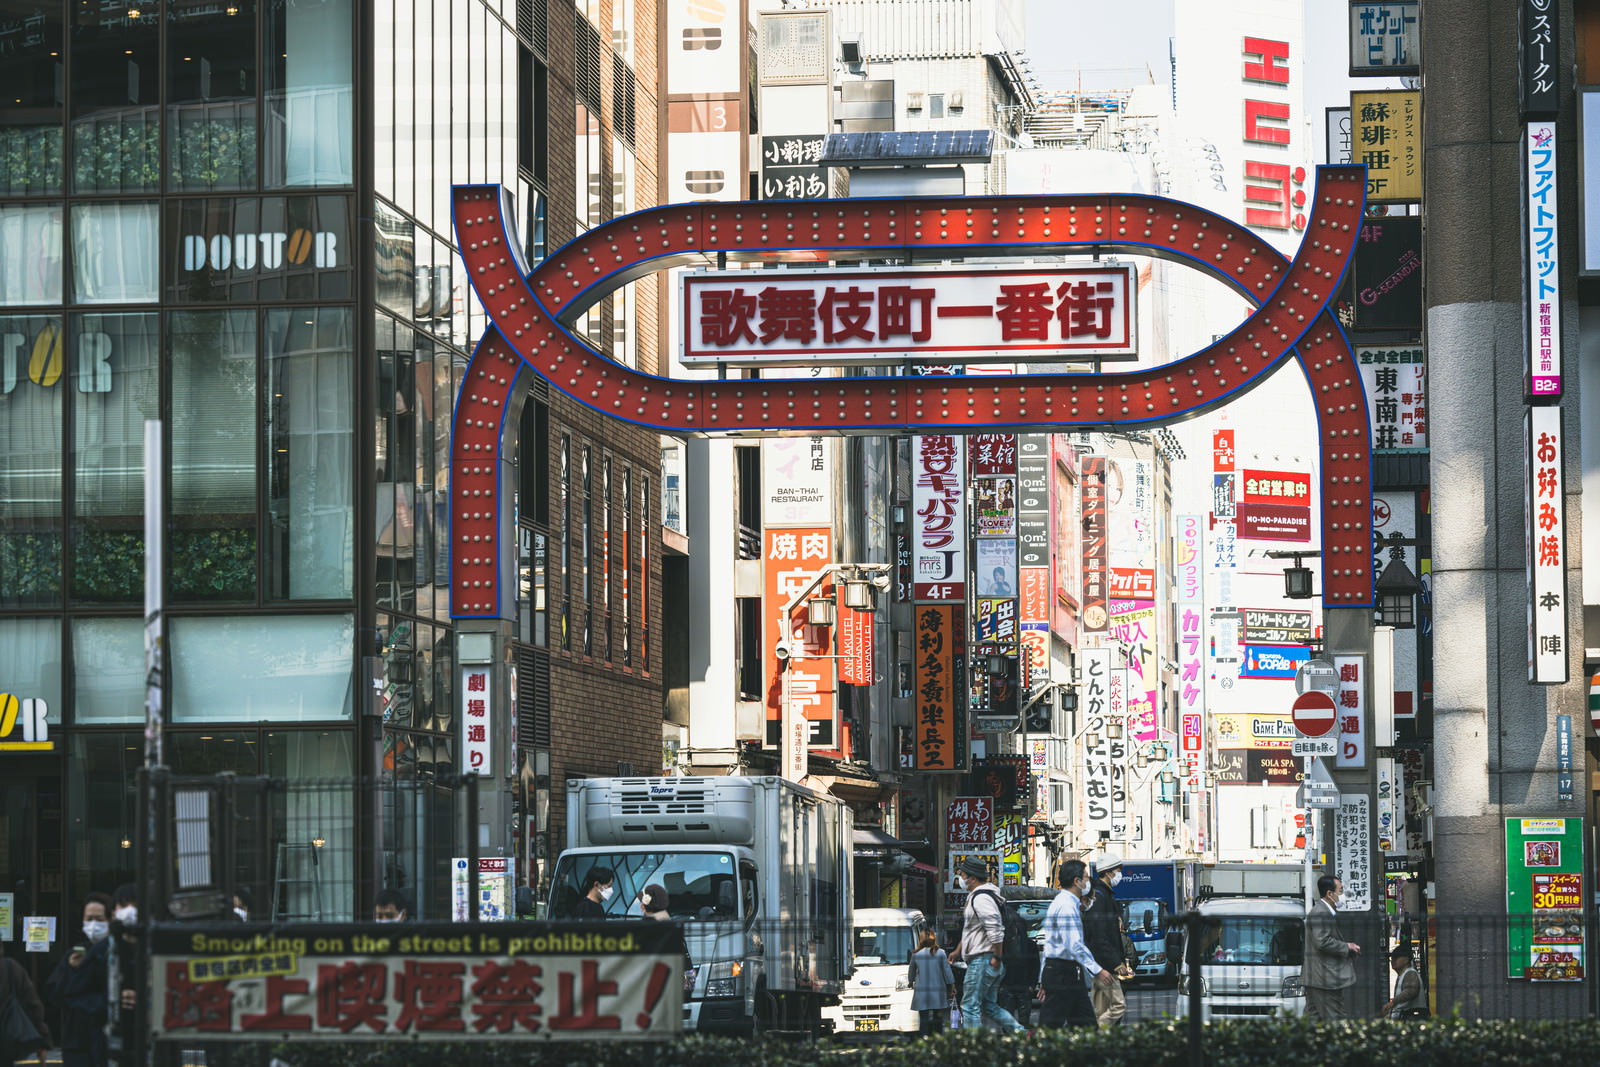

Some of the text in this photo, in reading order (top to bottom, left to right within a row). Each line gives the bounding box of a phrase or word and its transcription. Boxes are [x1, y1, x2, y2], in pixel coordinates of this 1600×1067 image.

[1360, 7, 1416, 35] ポケット
[1368, 37, 1406, 65] ビル
[1531, 15, 1554, 94] スパークル
[765, 139, 823, 164] 小料理
[1404, 99, 1414, 177] エレガンス・ラウンジ
[1361, 226, 1382, 242] 4F
[1531, 150, 1557, 300] ファイトフィット
[184, 228, 337, 271] DOUTOR
[700, 281, 1115, 346] 歌舞伎町一番街
[1540, 303, 1552, 371] 新宿東口駅前
[1360, 350, 1424, 365] 全卓全自動
[1535, 380, 1557, 391] B2F
[1375, 367, 1398, 448] 東南荘
[1414, 366, 1425, 434] リーチ麻雀
[1401, 393, 1413, 445] 専門店
[771, 495, 824, 503] RESTAURANT
[777, 487, 819, 496] BAN-THAI
[916, 435, 962, 549] 熟女キャバクラ
[1246, 478, 1307, 498] 全店営業中
[768, 533, 828, 560] 焼肉
[1537, 432, 1562, 656] お好み焼 本陣
[927, 584, 952, 599] 4F
[981, 601, 992, 639] カフェ
[1182, 608, 1200, 706] カラオケ
[467, 673, 486, 768] 劇場通り
[1340, 663, 1360, 759] 劇場通り
[1253, 719, 1295, 735] GAME PANI
[1295, 743, 1334, 753] 自転車を除く
[1216, 772, 1242, 780] AUNA
[1261, 759, 1279, 767] SOLA
[1560, 780, 1571, 788] 17
[1348, 804, 1360, 892] 防犯カメラ作動中
[1387, 862, 1407, 870] B1F
[1535, 893, 1580, 908] 30円引き
[314, 937, 343, 951] on
[351, 935, 391, 952] the
[399, 936, 472, 952] street
[480, 933, 505, 951] is
[508, 933, 640, 956] prohibited.
[1541, 953, 1572, 962] おでん
